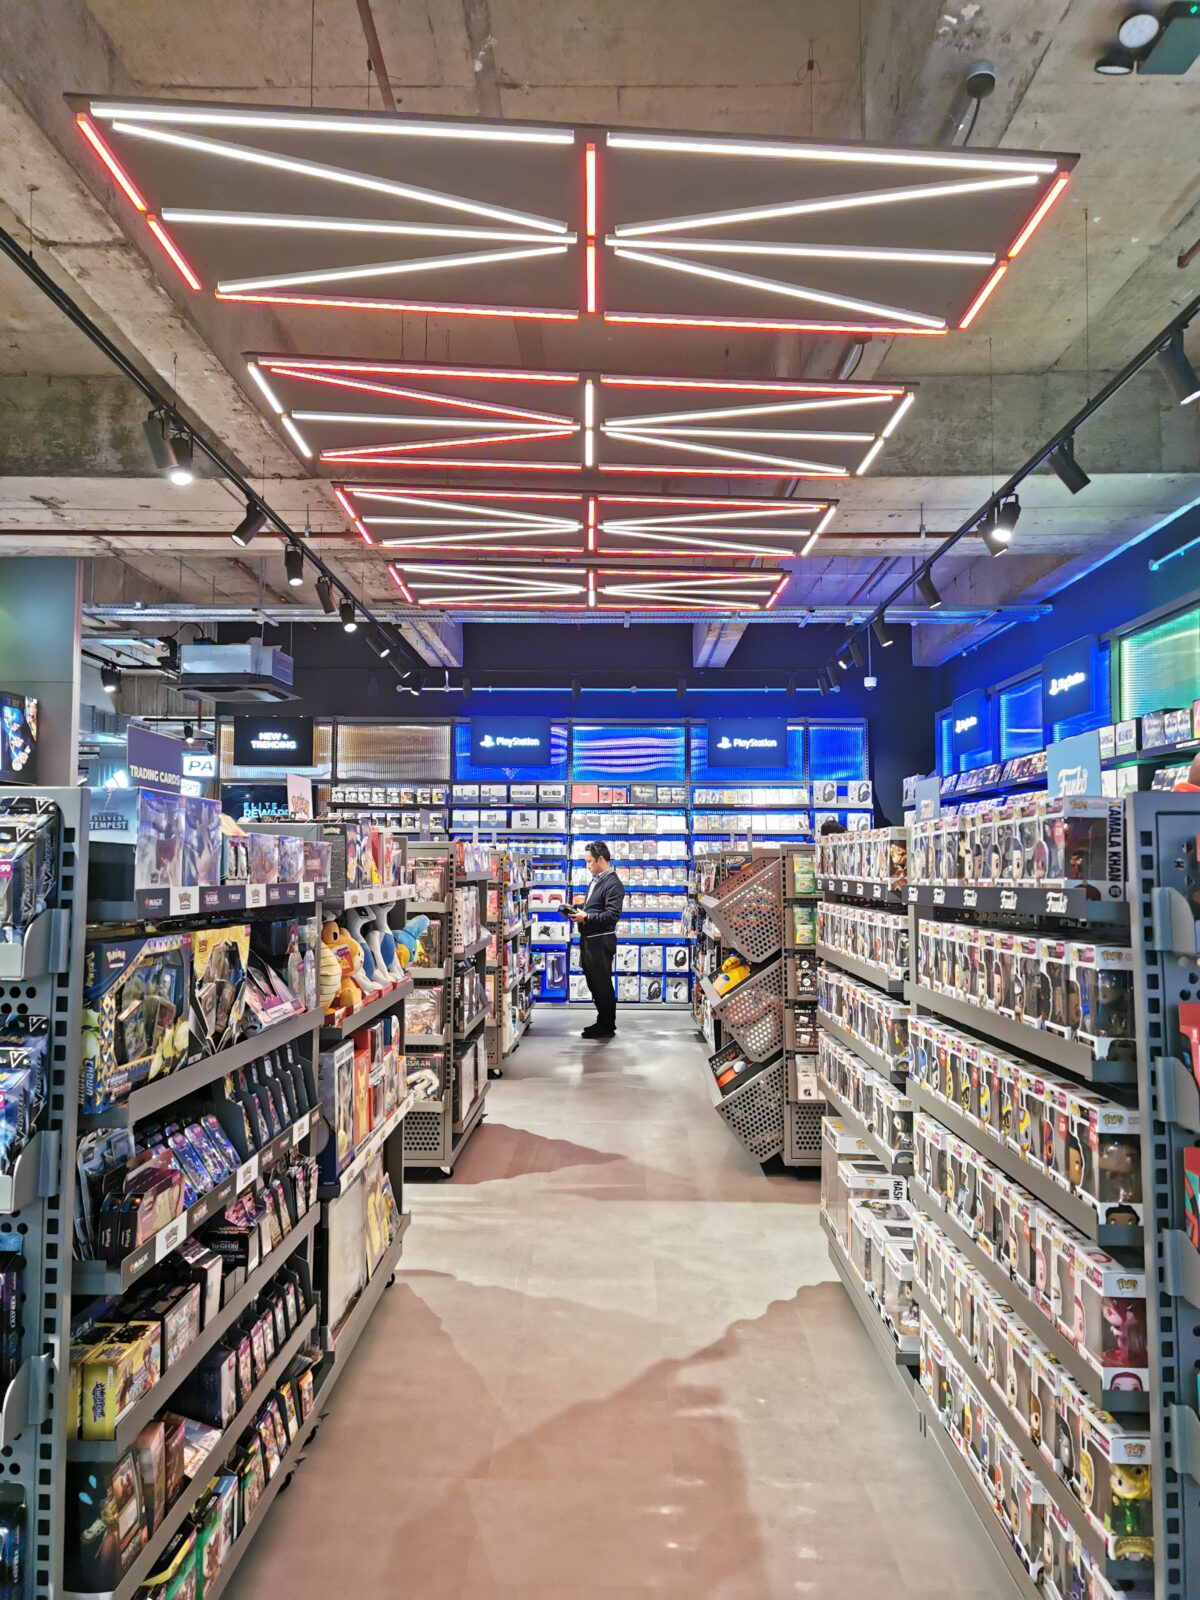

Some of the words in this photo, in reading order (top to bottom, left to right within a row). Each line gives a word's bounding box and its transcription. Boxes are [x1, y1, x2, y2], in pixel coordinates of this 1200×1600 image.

[251, 740, 297, 749] TRENDING
[259, 732, 281, 740] NEW
[496, 736, 540, 748] PlayStation
[733, 737, 777, 749] PlayStation
[129, 764, 159, 782] TRADING
[159, 771, 180, 786] CARDS
[1058, 766, 1089, 796] Funko
[89, 821, 127, 829] TEMPEST
[1108, 802, 1122, 848] KAMALA
[1108, 851, 1122, 882] KHAN
[1046, 891, 1068, 913] Funko
